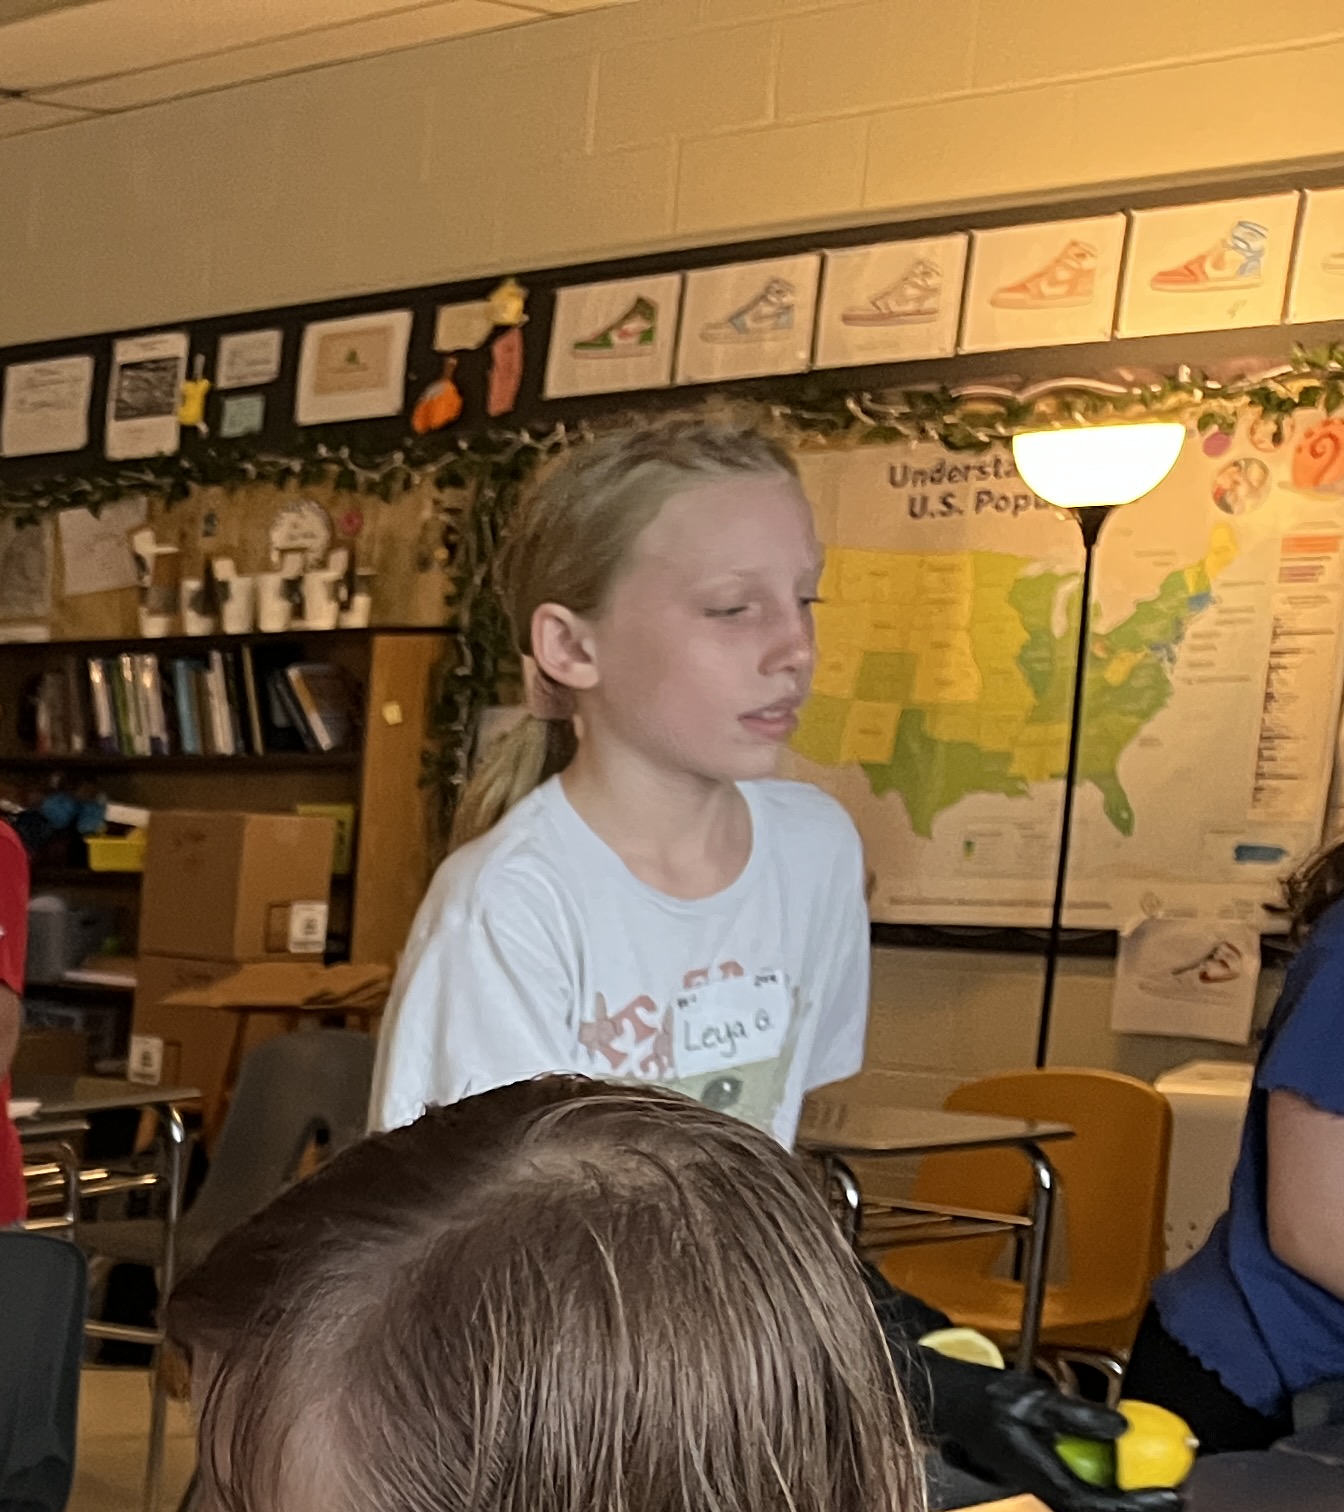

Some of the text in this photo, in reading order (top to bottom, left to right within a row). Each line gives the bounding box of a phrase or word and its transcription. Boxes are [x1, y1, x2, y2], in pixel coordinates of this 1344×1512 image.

[889, 456, 1020, 488] Understa
[908, 488, 1050, 520] U.S. Popu
